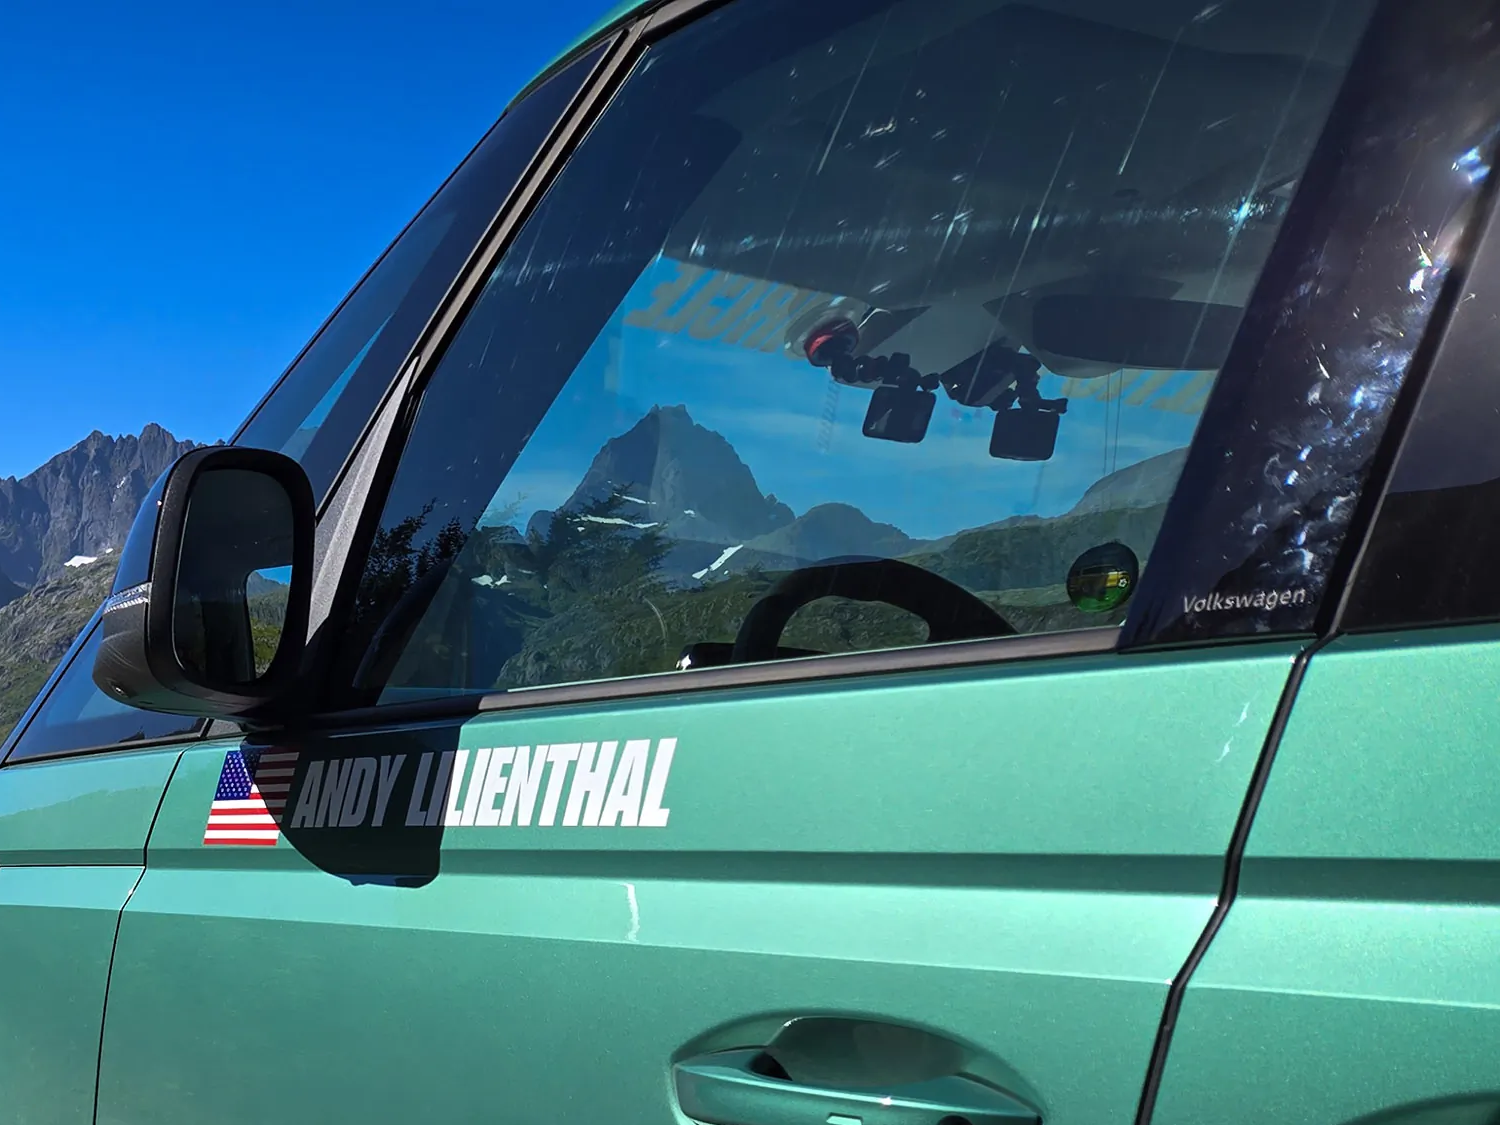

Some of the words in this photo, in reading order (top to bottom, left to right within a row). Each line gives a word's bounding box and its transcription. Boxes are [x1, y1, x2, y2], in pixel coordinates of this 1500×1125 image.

[1183, 587, 1306, 614] Volkswagen
[290, 752, 407, 829] ANDY
[405, 737, 678, 827] LILIENTHAL
